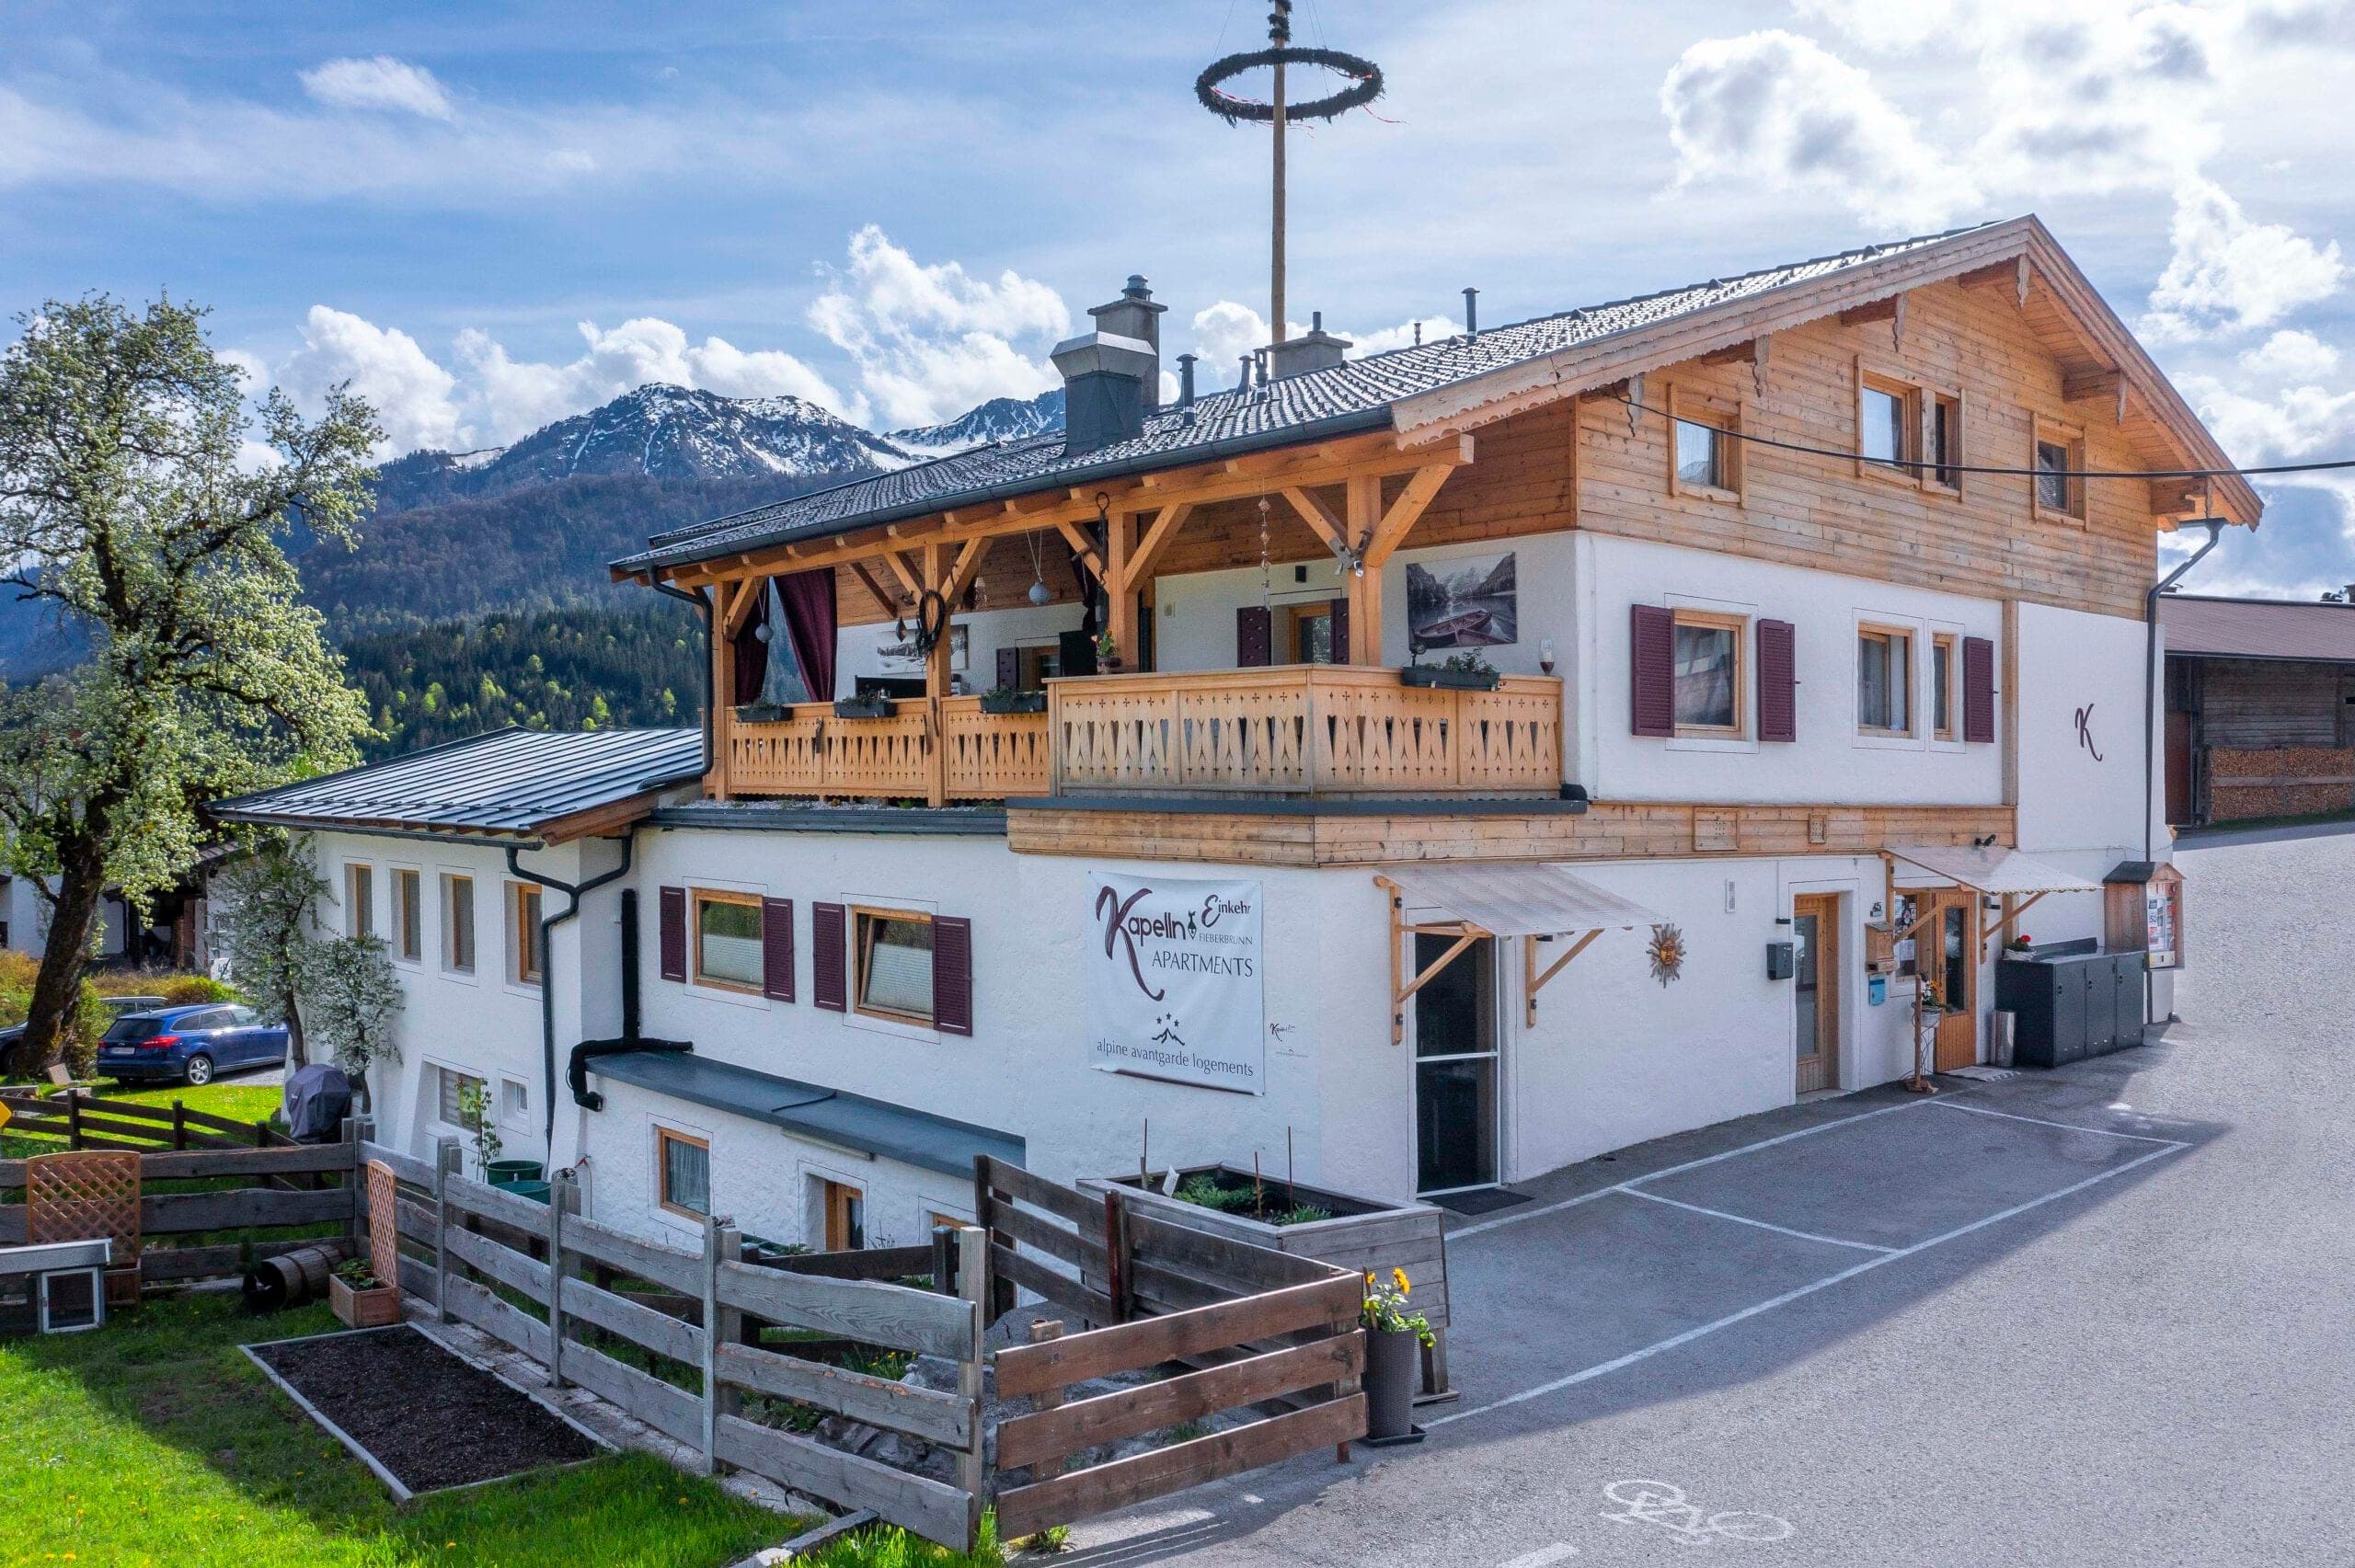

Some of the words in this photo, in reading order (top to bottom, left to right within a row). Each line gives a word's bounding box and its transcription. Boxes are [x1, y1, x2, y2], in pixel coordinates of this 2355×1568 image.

[2074, 703, 2103, 762] K
[1201, 894, 1251, 928] Einkehr
[1096, 886, 1186, 1001] Kapelln
[1199, 933, 1253, 945] FIEBERBRUNN
[1152, 950, 1253, 978] APARTMENTS
[1097, 1038, 1128, 1057] alpine
[1132, 1045, 1189, 1067] avantgarde
[1192, 1053, 1254, 1077] logements
